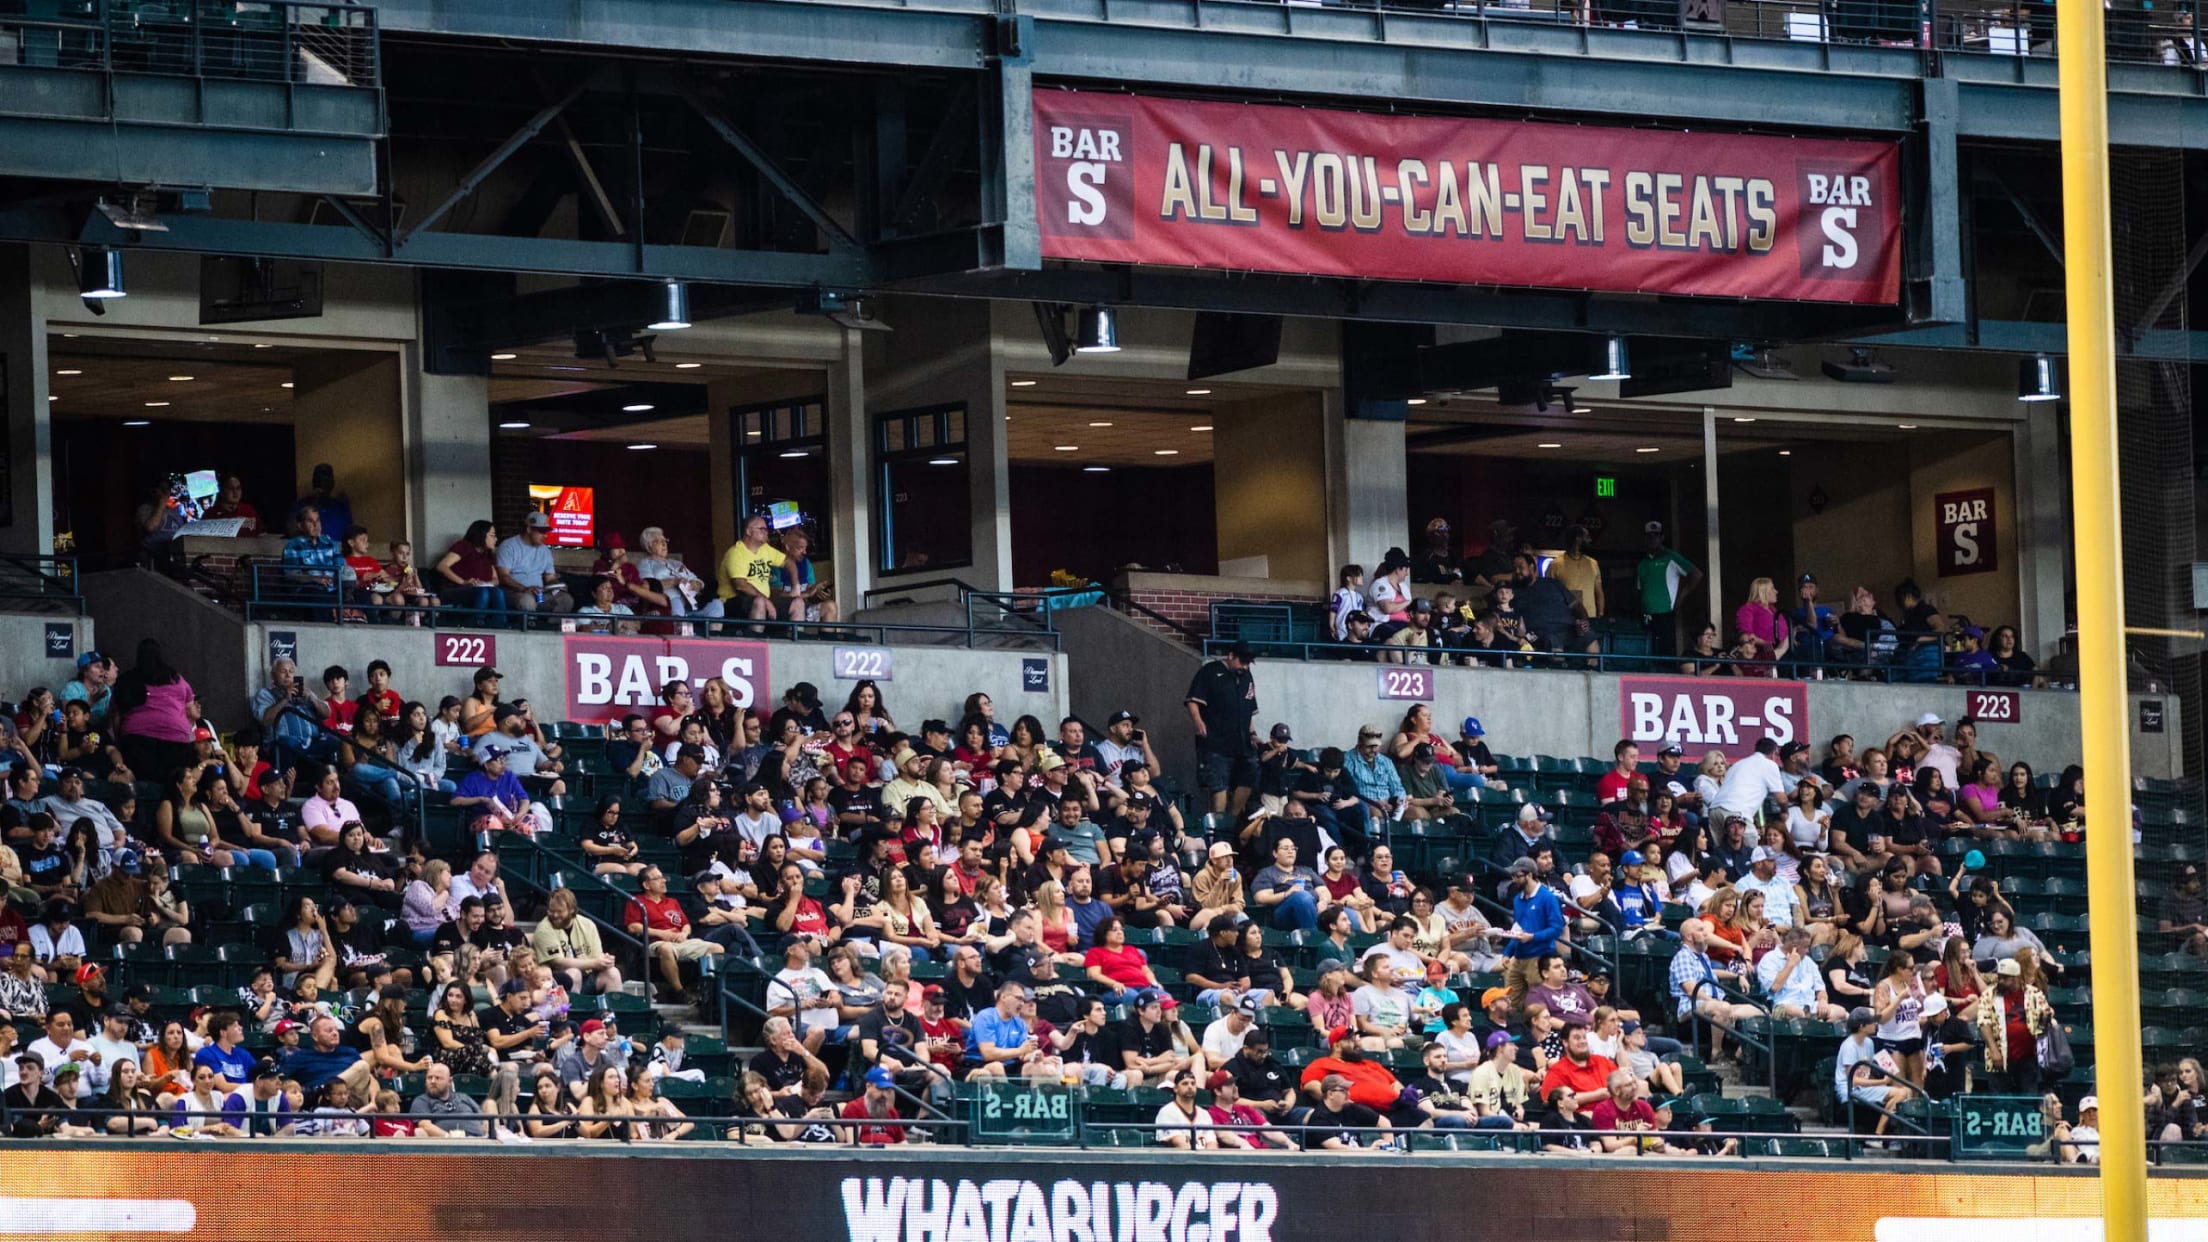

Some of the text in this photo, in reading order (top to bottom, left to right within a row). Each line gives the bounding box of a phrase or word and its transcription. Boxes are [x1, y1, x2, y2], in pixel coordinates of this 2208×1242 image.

[1051, 126, 1122, 161] BAR
[1067, 162, 1106, 226] S
[1161, 142, 1777, 252] ALL-YOU-CAN-EAT SEATS
[1807, 173, 1872, 207] BAR
[1820, 207, 1859, 270] S
[1597, 478, 1615, 497] EXIT
[1944, 500, 1988, 525] BAR
[1954, 522, 1980, 566] S
[446, 637, 486, 663] 222
[845, 651, 882, 676] 222
[1388, 672, 1424, 696] 223
[1631, 692, 1794, 746] BAR-S
[1977, 694, 2011, 718] 223
[841, 1176, 1279, 1242] WHATABURGER
